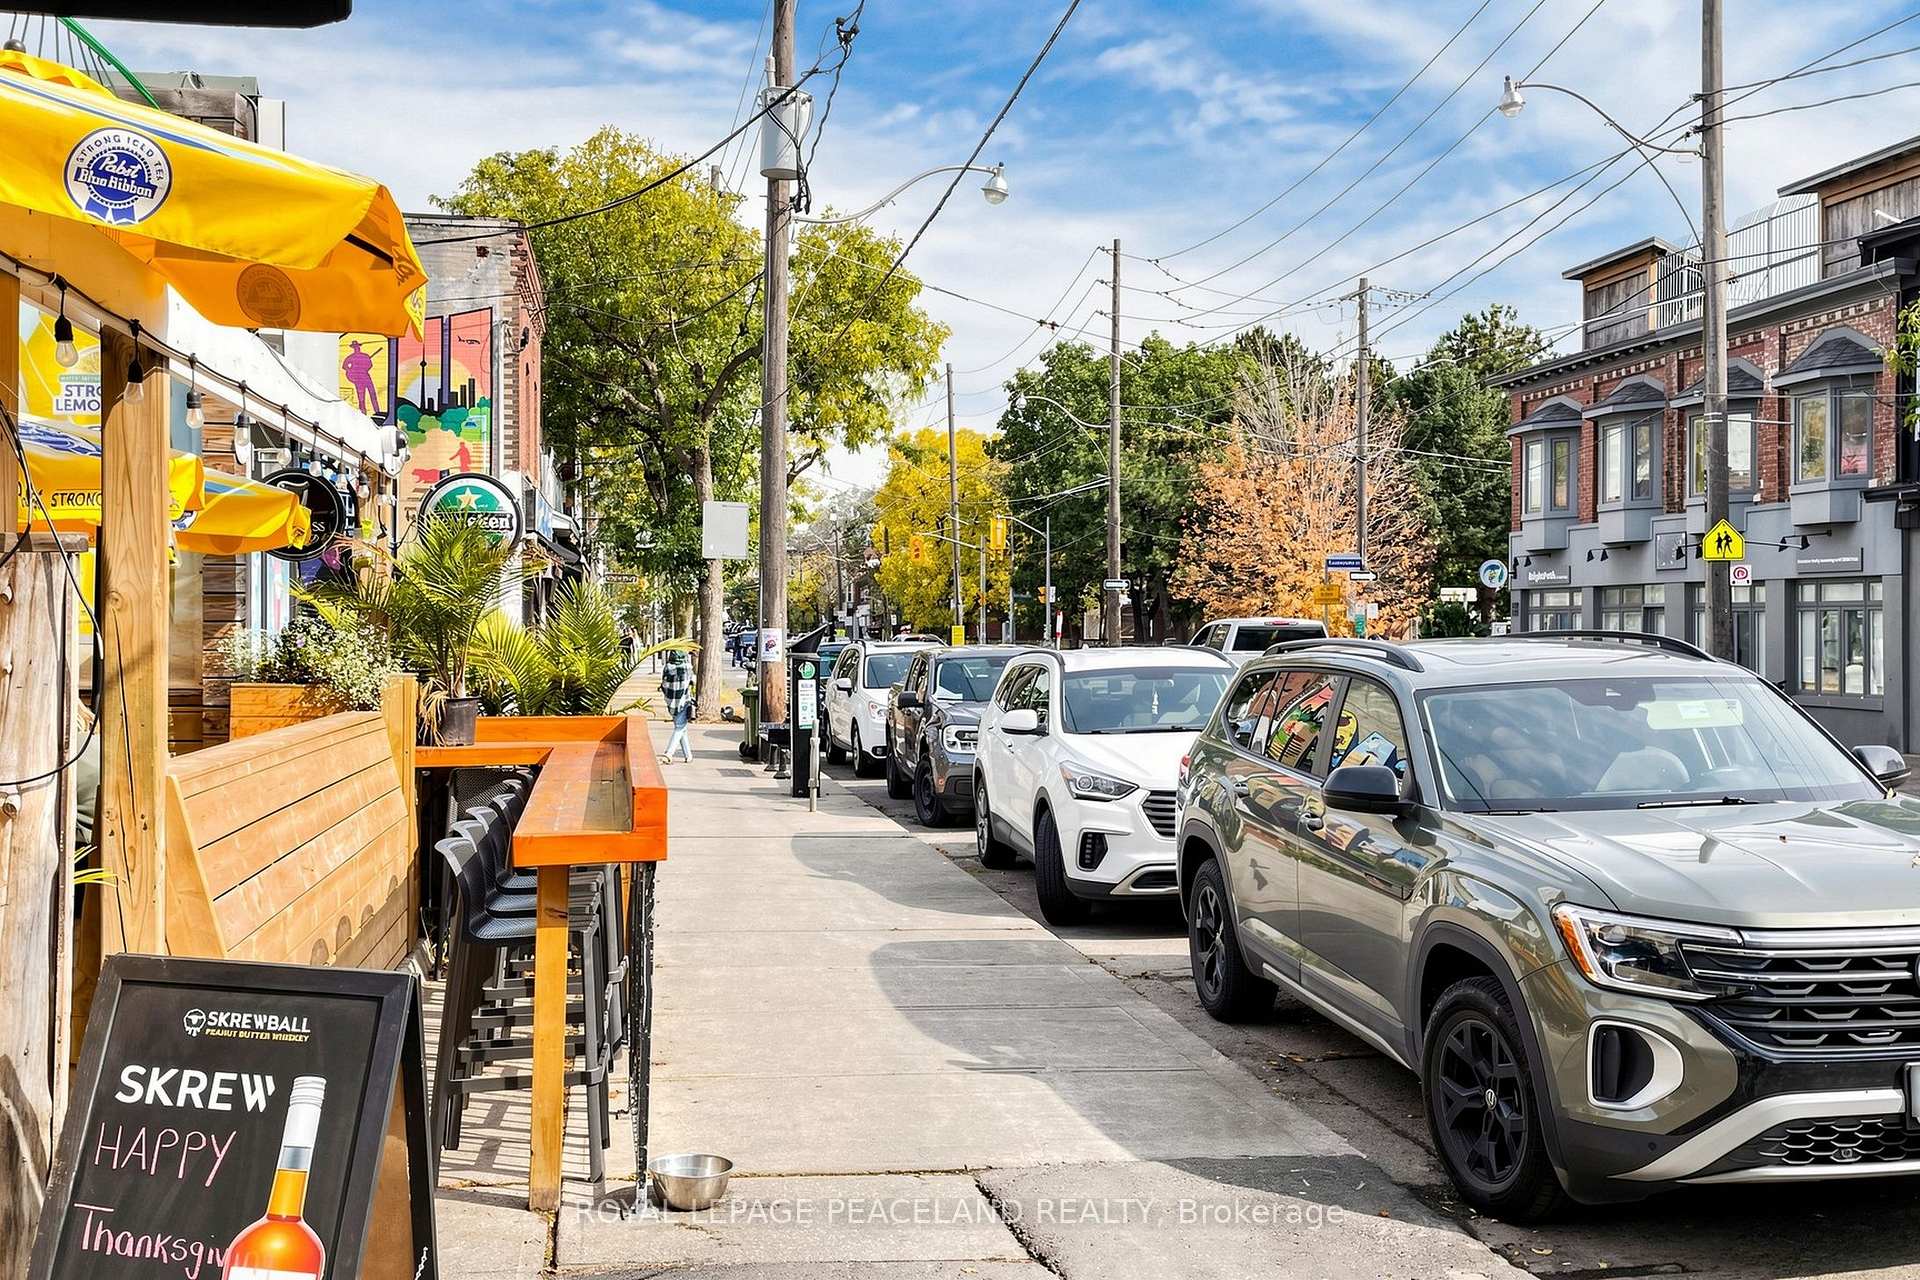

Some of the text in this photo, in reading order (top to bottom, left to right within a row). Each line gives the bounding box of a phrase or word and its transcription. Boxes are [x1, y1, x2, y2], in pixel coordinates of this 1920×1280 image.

[76, 134, 121, 163] STRONG
[99, 153, 142, 179] Pabst
[78, 168, 153, 198] Blue Ribbon
[205, 1028, 310, 1043] PEANUT BUTTER WHISKEY
[207, 1011, 311, 1033] SKREWBALL
[115, 1064, 276, 1113] SKREW
[94, 1122, 237, 1188] HAPPY
